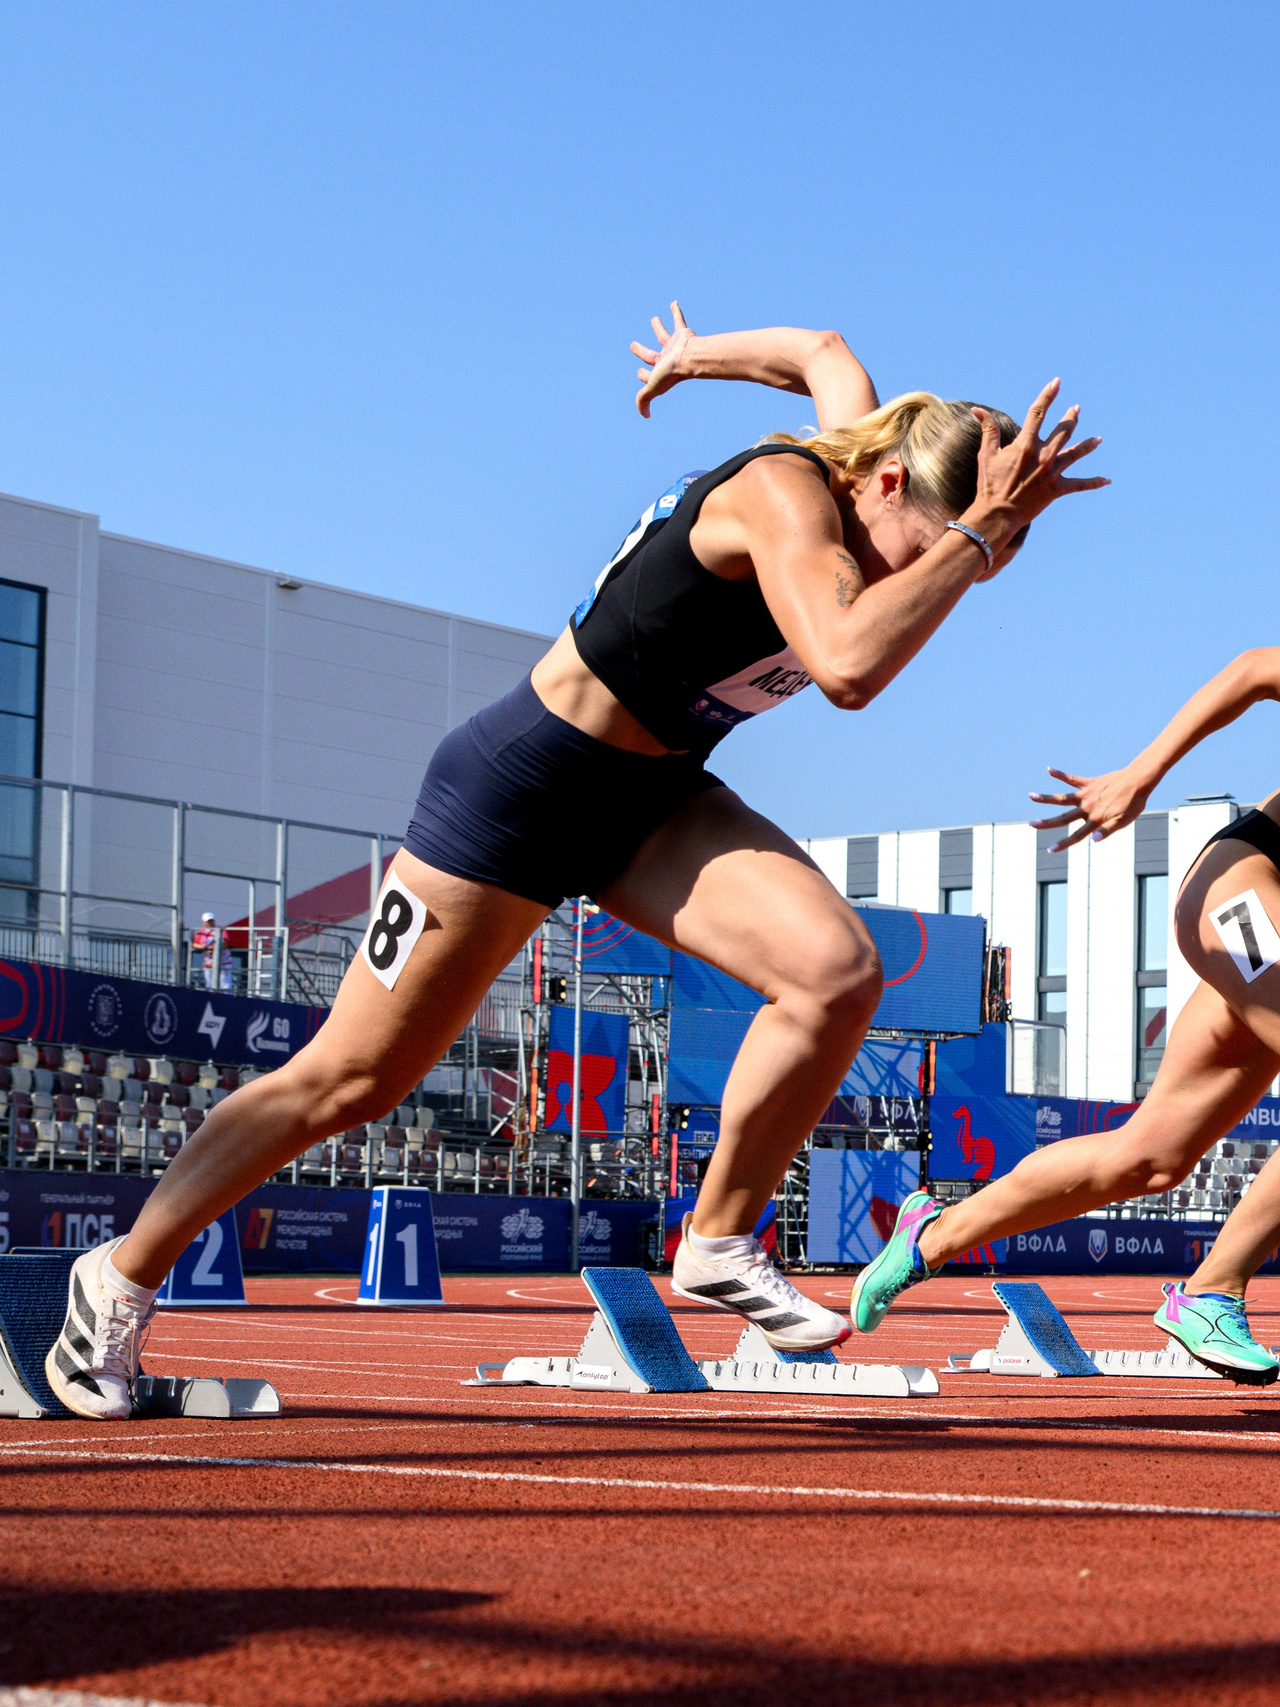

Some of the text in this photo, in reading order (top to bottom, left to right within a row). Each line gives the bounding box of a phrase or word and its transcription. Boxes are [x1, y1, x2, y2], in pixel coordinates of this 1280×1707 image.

[369, 889, 413, 971] 8
[1218, 901, 1264, 972] 7
[273, 1018, 290, 1038] 60
[65, 1213, 116, 1248] ПСБ
[191, 1220, 223, 1286] 2
[366, 1223, 380, 1286] 1
[1017, 1234, 1067, 1252] ВФЛА
[1115, 1237, 1164, 1254] ВФЛА
[396, 1224, 419, 1286] 1
[583, 1371, 609, 1380] onlytop
